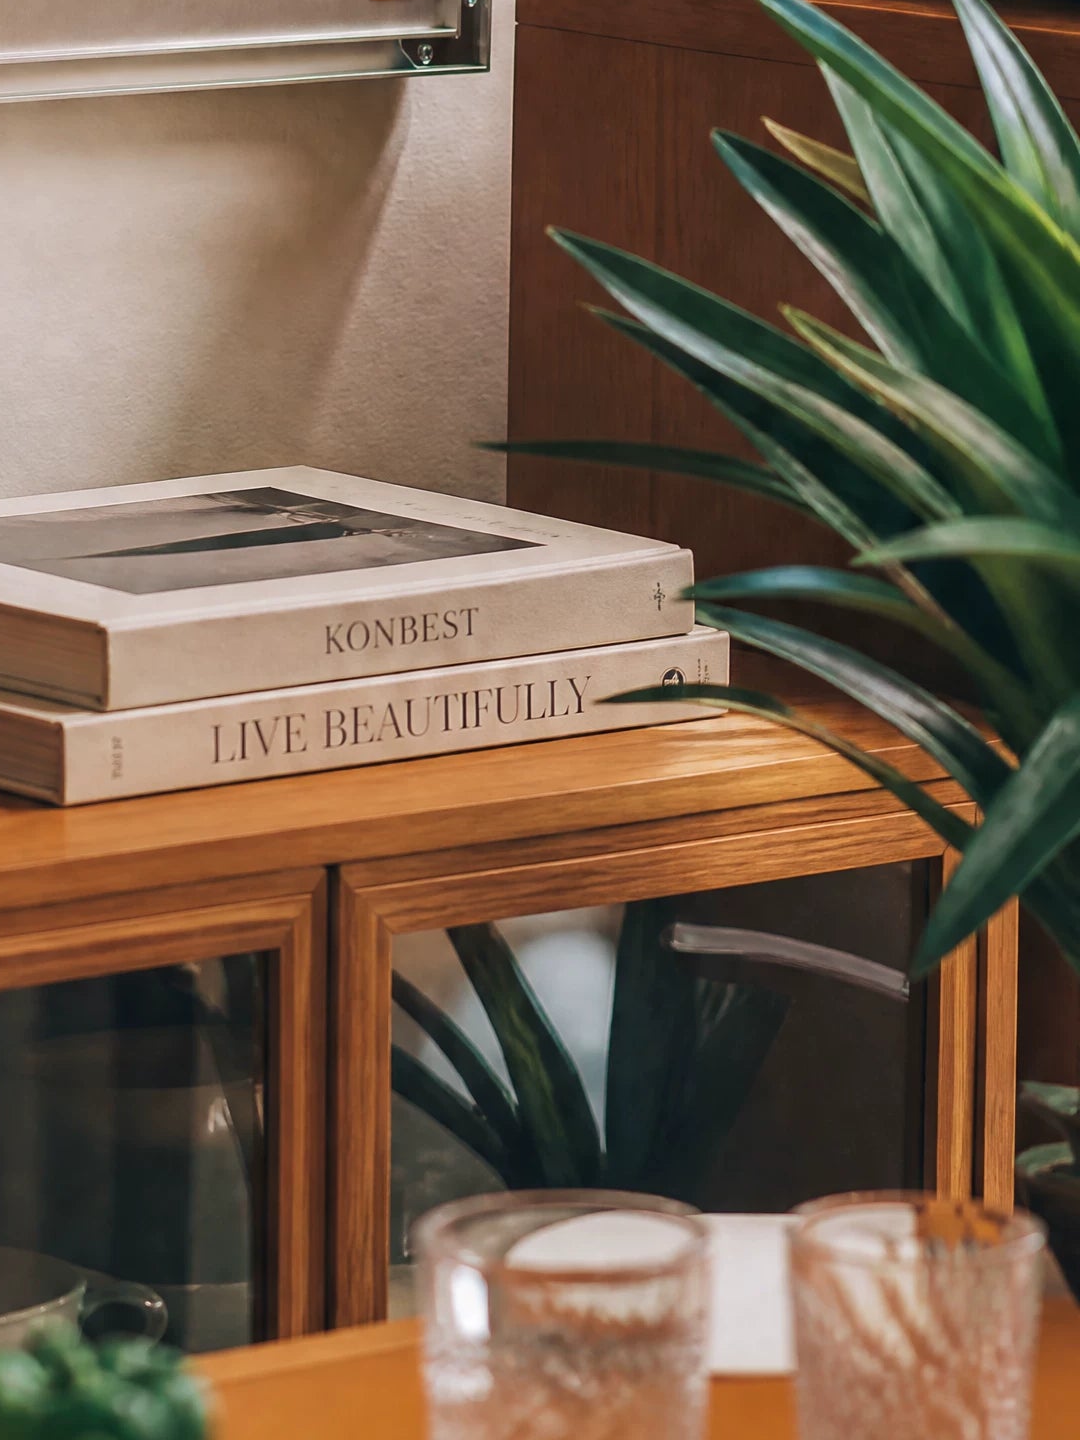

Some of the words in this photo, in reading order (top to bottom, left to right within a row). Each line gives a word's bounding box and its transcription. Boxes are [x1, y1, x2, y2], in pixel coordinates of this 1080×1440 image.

[325, 607, 479, 655] KONBEST
[212, 713, 308, 764] LIVE
[323, 675, 592, 749] BEAUTIFULLY
